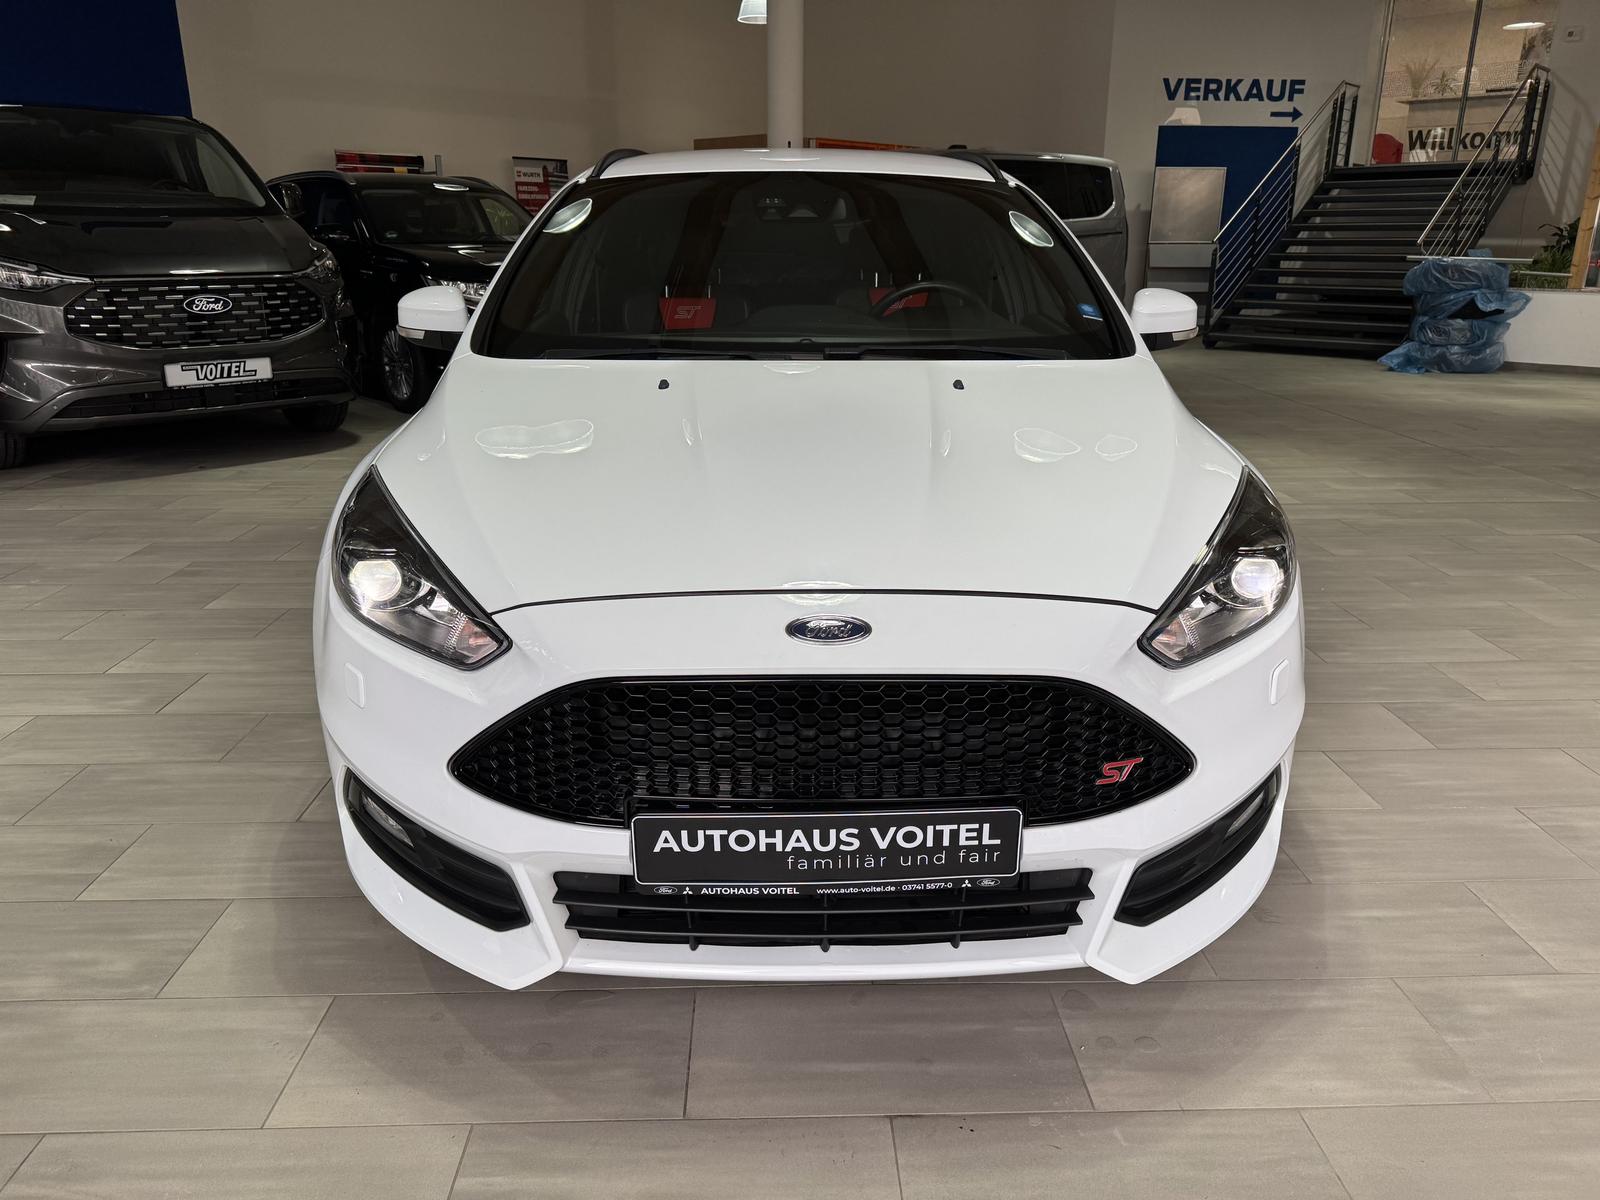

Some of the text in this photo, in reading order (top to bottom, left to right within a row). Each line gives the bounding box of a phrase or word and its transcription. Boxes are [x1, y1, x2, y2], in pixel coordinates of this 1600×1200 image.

[1162, 78, 1307, 102] VERKAUF
[192, 297, 224, 311] Ford
[674, 305, 704, 319] ST
[195, 361, 248, 380] VOITEL
[804, 619, 852, 638] Ford
[1095, 757, 1144, 785] ST
[652, 823, 1001, 853] AUTOHAUS VOITEL
[786, 848, 1002, 871] familiär und fair
[700, 887, 800, 895] AUTOHAUS VOITEL
[816, 881, 953, 895] www.auto-voitel.de 03741 5577-0
